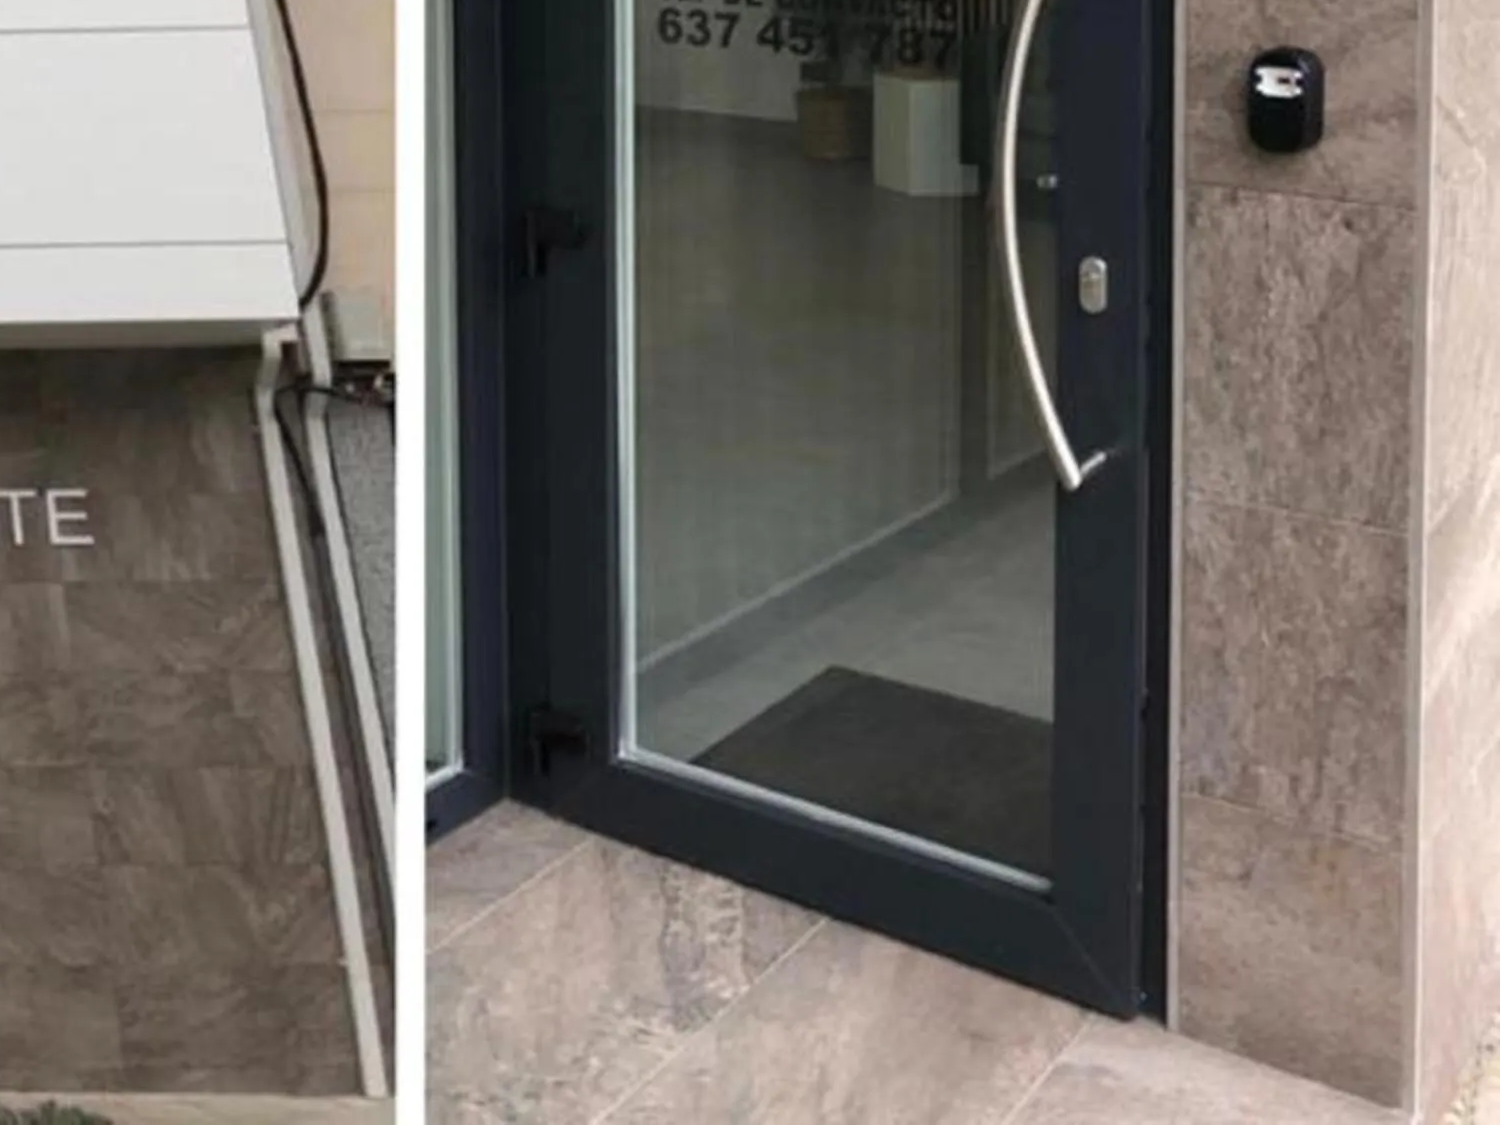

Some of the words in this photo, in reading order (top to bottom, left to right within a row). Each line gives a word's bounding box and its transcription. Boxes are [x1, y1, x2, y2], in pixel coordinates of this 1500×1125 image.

[657, 6, 740, 49] 637
[756, 14, 840, 57] 451
[864, 20, 958, 70] 787
